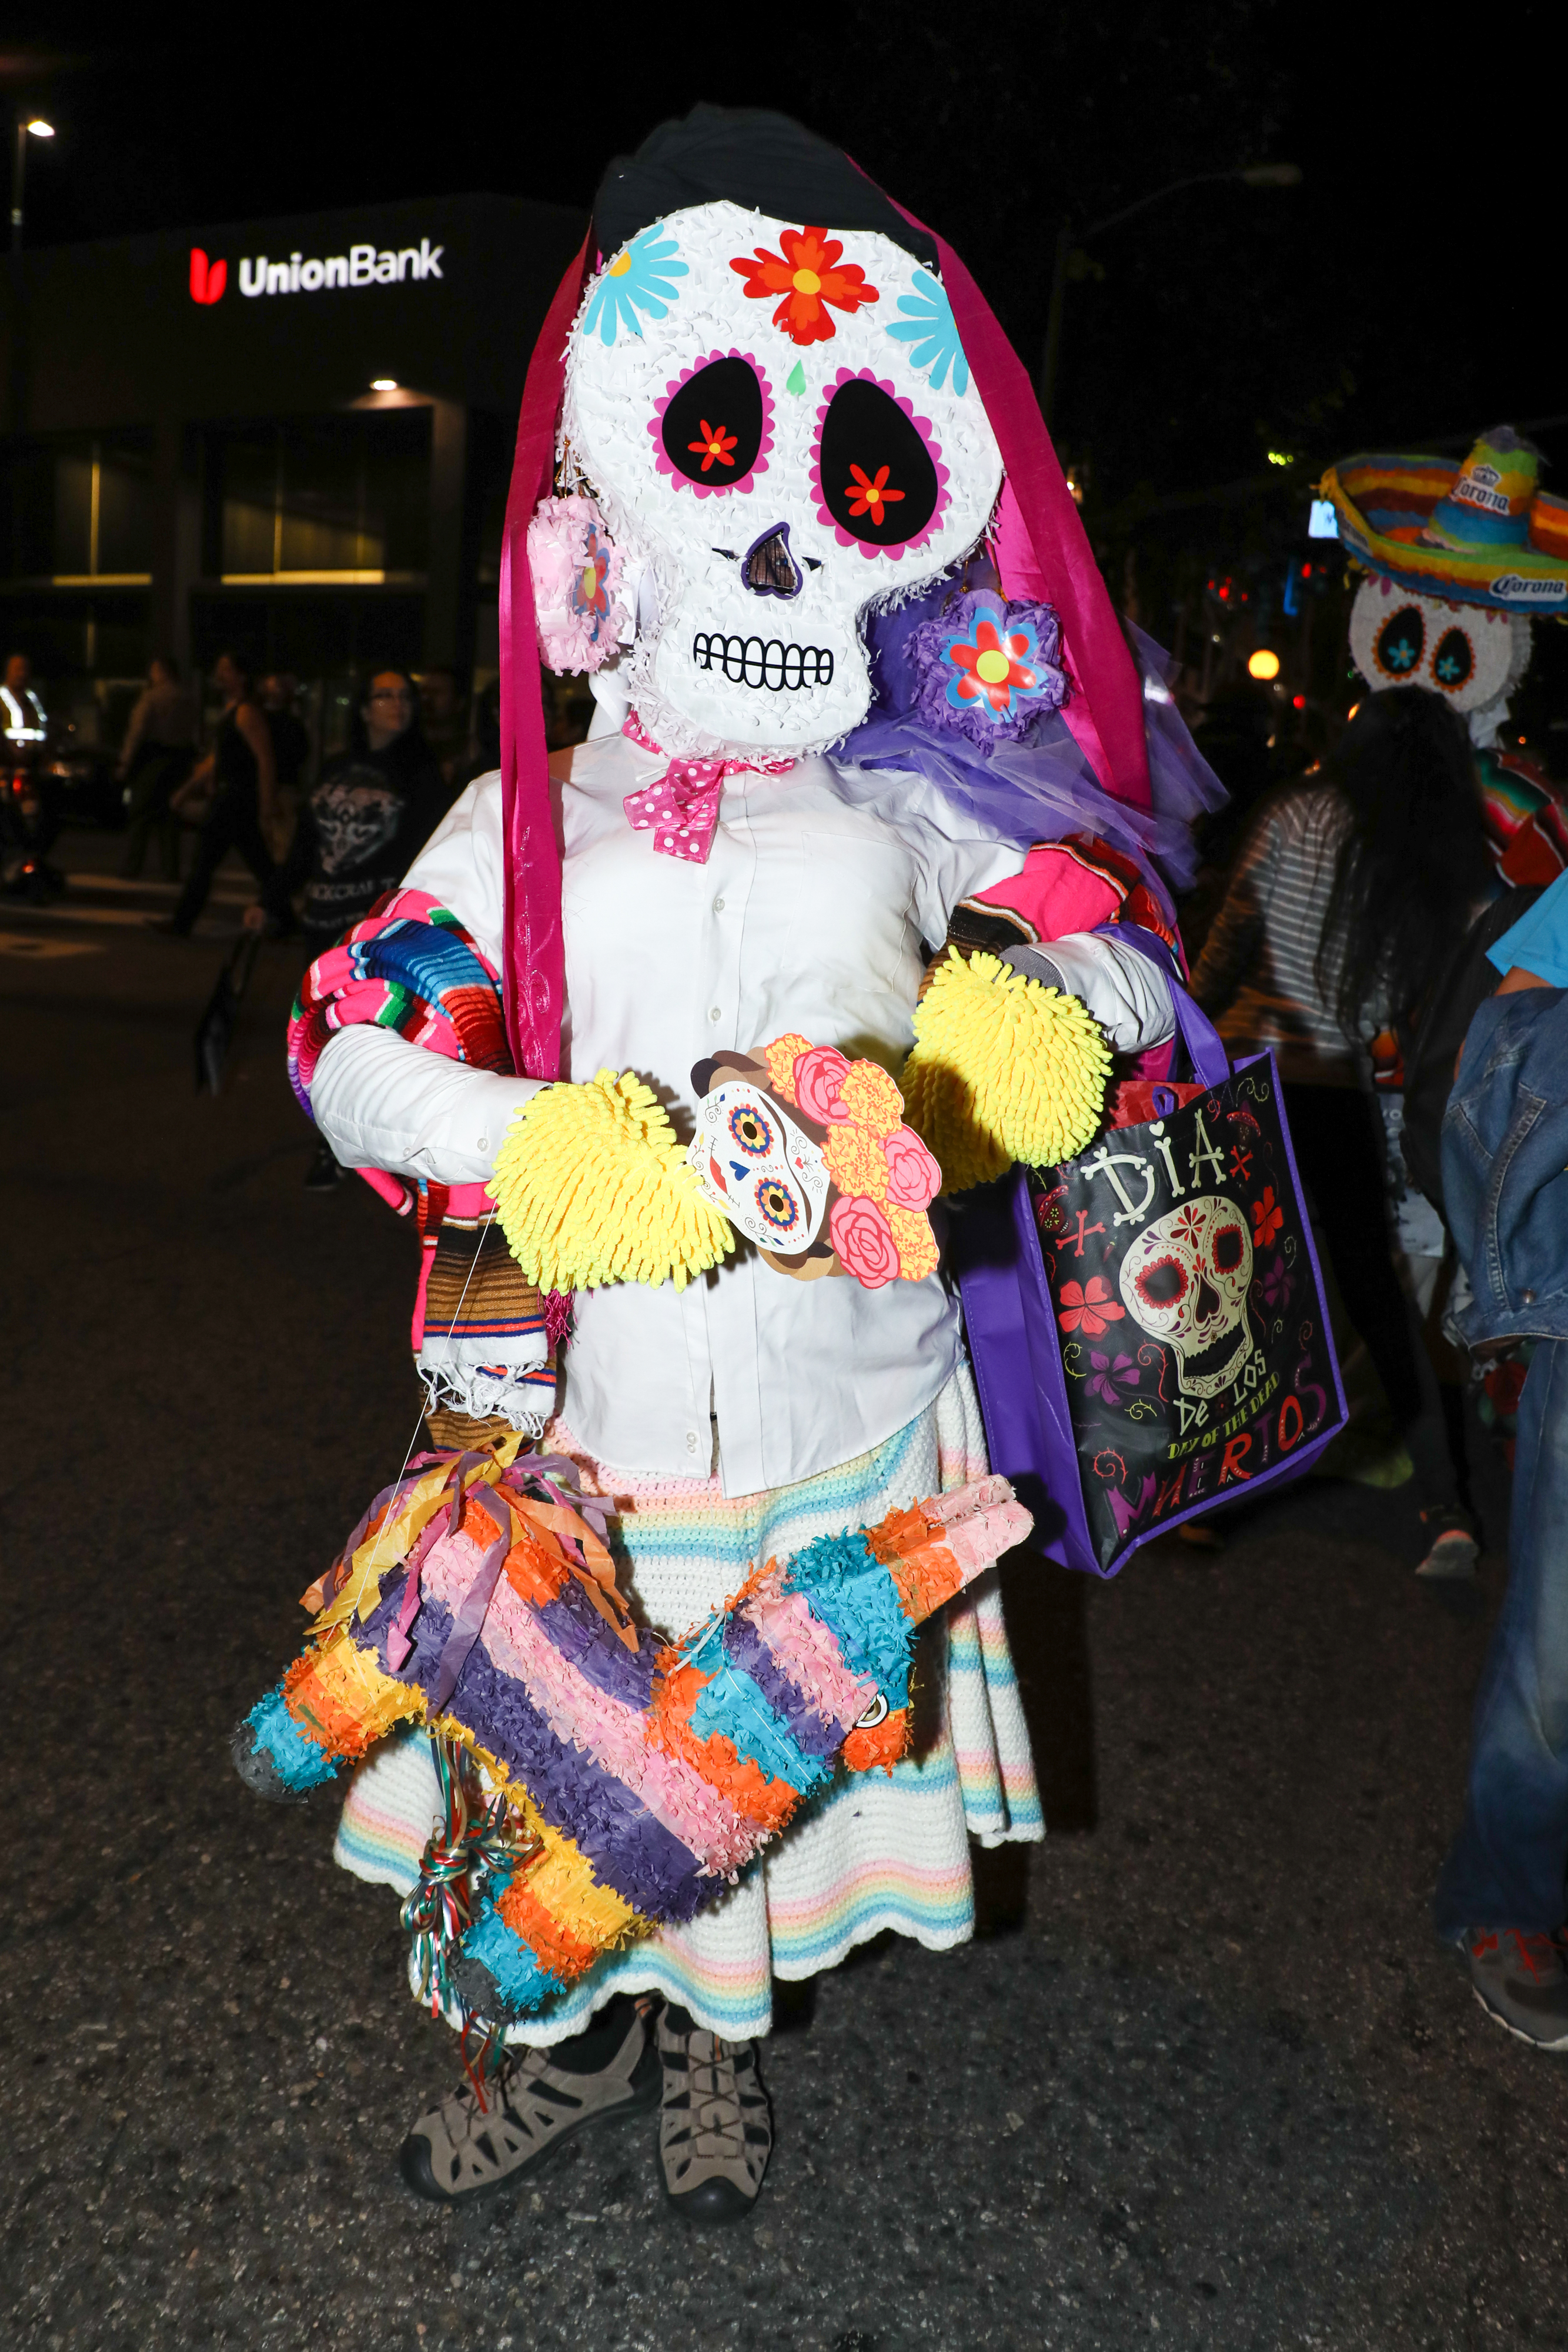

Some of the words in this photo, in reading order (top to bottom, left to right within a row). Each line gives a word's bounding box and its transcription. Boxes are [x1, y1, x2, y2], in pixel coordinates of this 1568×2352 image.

[239, 238, 444, 297] UnionBank
[1451, 476, 1510, 511] Corona
[1492, 574, 1566, 596] Corona
[1233, 1349, 1266, 1406] LOS
[1167, 1436, 1200, 1459] DAY
[1201, 1426, 1220, 1448] OF
[1222, 1405, 1249, 1438] THE
[1250, 1371, 1280, 1414] DEAD
[1106, 1352, 1327, 1539] MUERTOS
